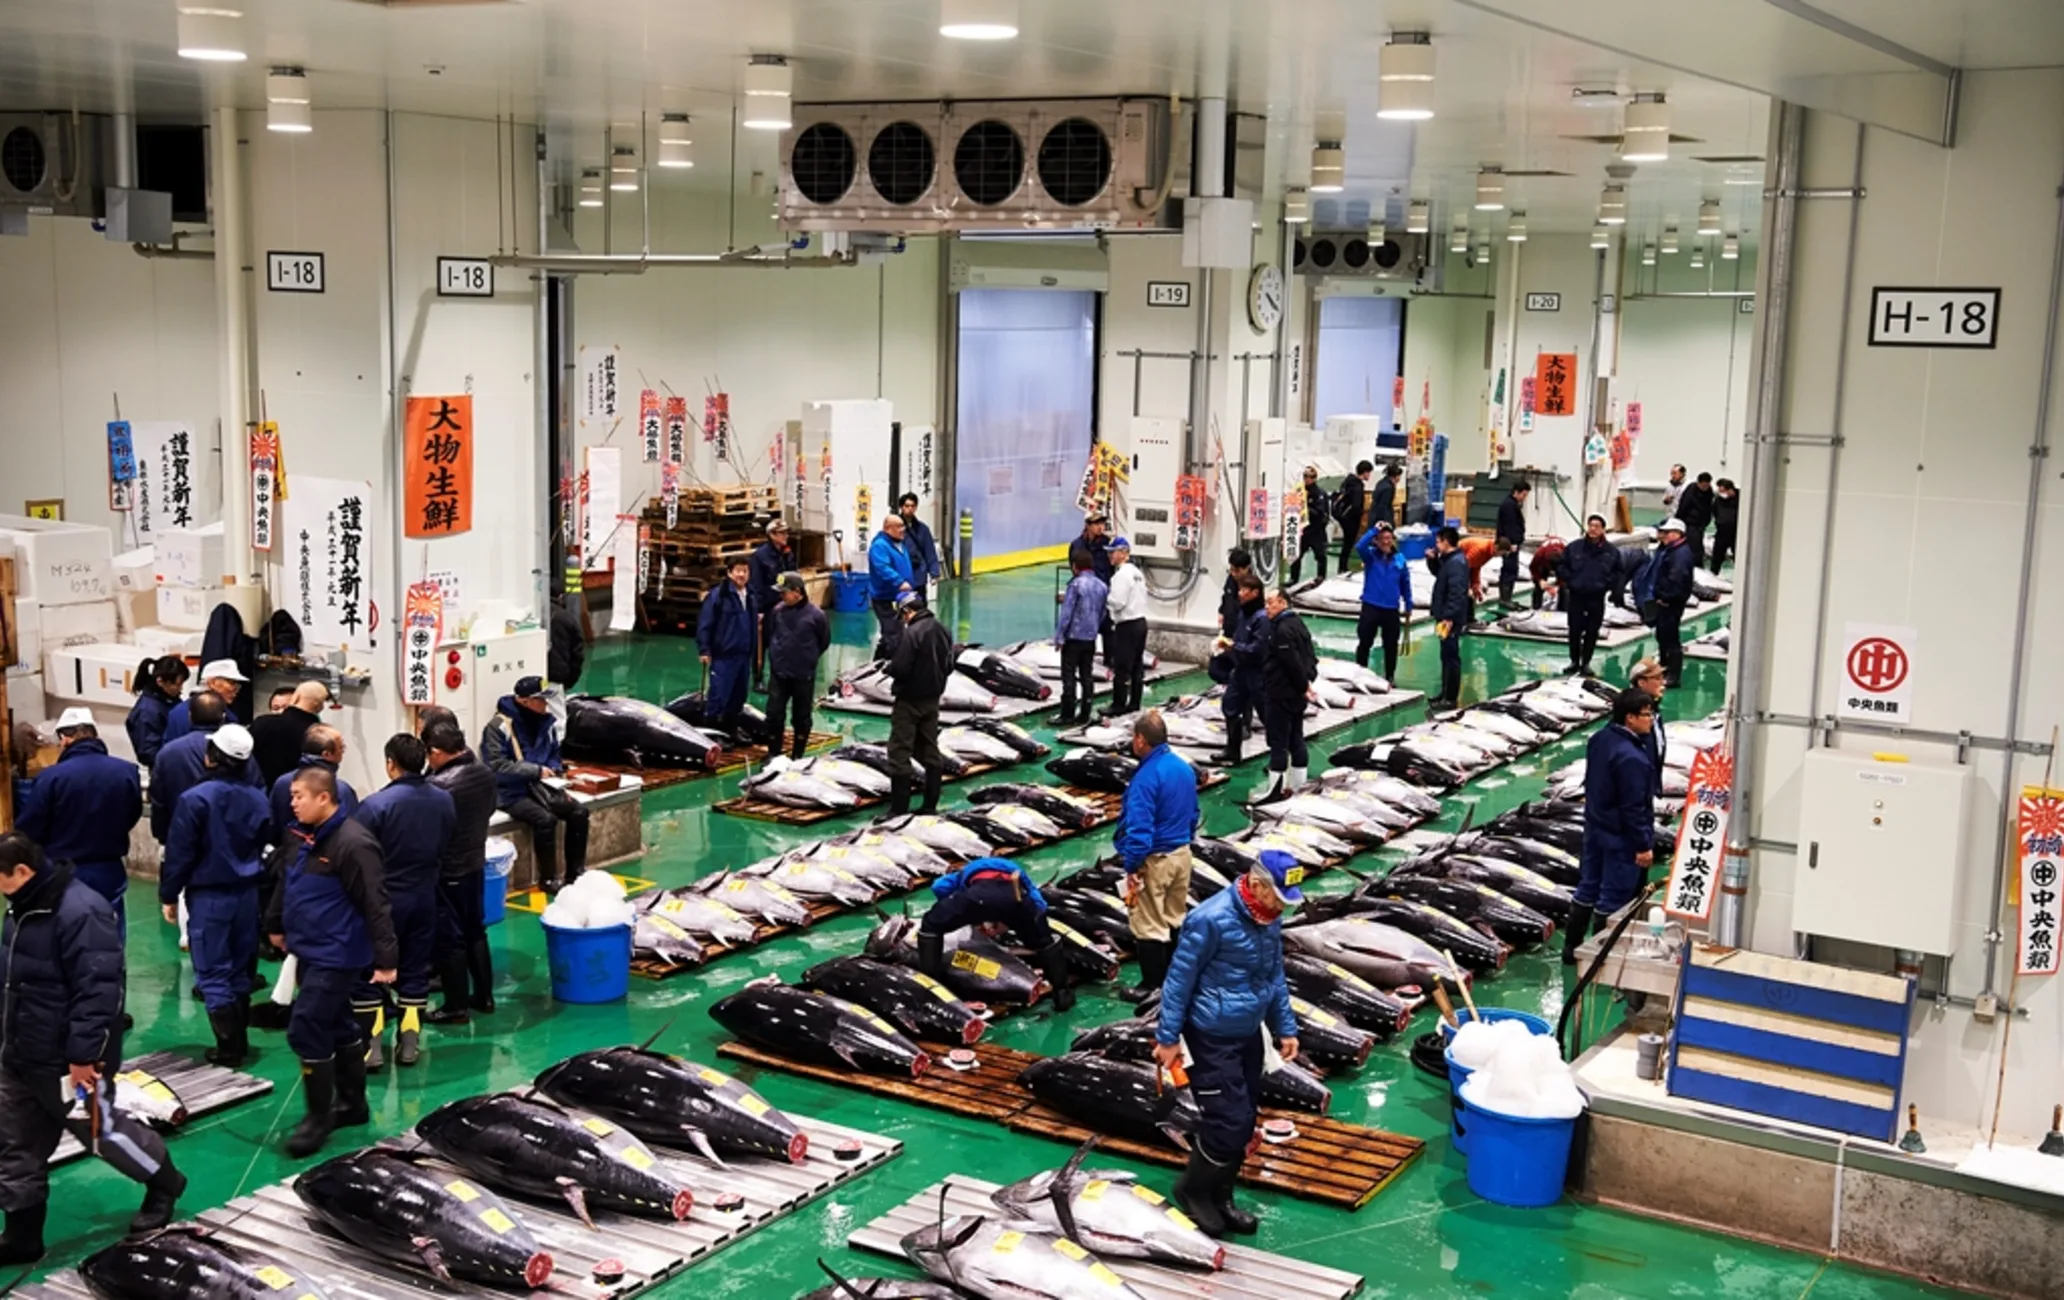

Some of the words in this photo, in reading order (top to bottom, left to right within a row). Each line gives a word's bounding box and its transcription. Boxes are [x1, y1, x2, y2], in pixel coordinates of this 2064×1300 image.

[278, 260, 315, 284] I-18
[448, 265, 485, 289] I-18
[1155, 287, 1183, 302] I-19
[1532, 297, 1554, 308] I-20
[1884, 300, 1987, 335] H-18
[1544, 355, 1567, 414] 大物生鮮
[168, 431, 193, 528] 謹賀新年
[421, 400, 463, 531] 大物生鮮
[337, 496, 363, 636] 謹賀新年
[409, 649, 428, 701] 中央魚類
[1848, 697, 1899, 713] 中央魚類
[1675, 837, 1714, 913] 中央魚類
[2026, 889, 2055, 969] 中央魚類
